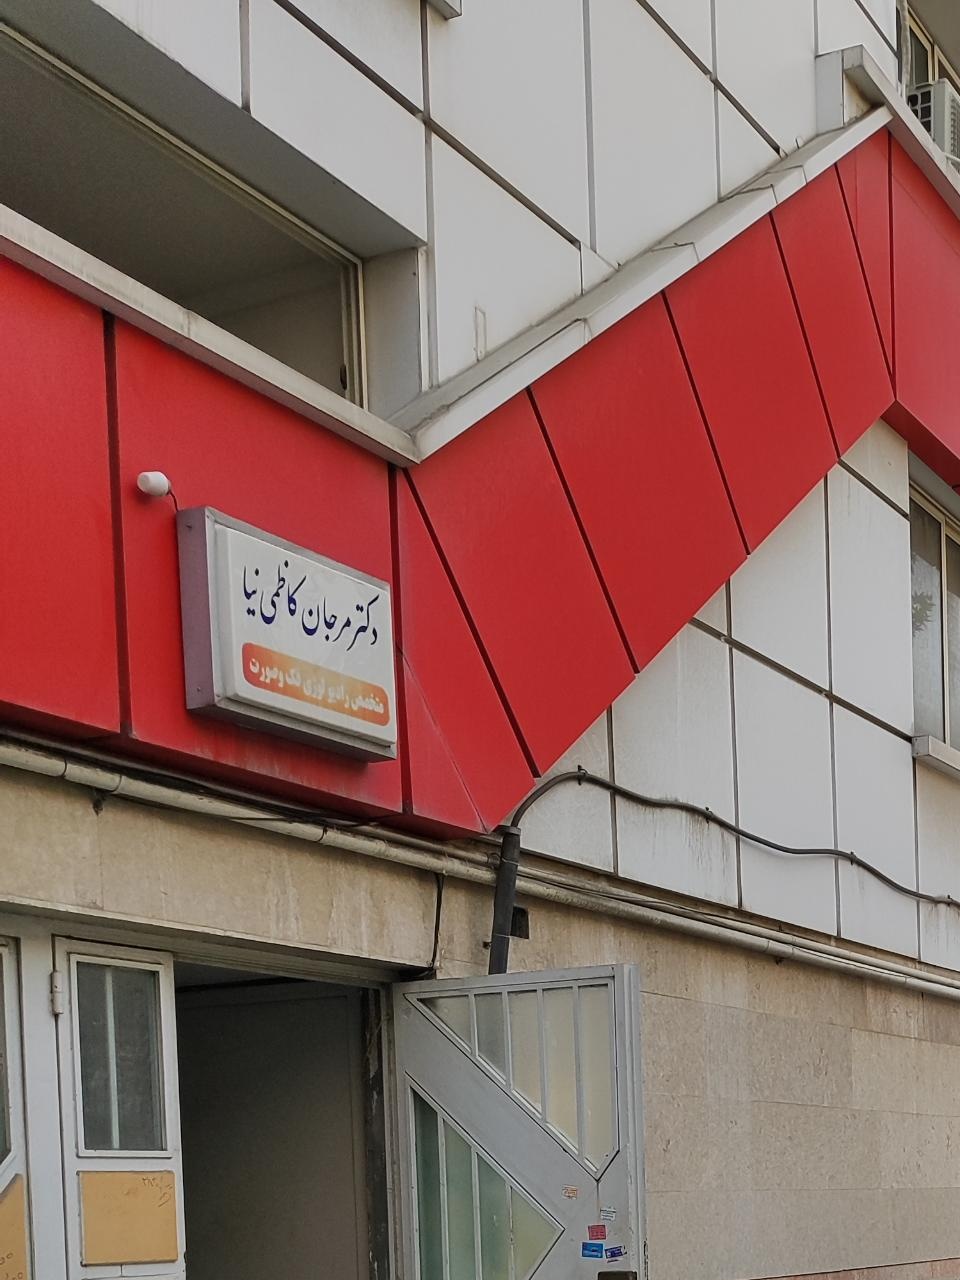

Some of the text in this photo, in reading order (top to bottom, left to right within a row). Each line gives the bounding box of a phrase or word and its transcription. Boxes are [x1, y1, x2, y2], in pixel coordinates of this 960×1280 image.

[242, 559, 380, 651] دکتر مرجان کاظمی نیا
